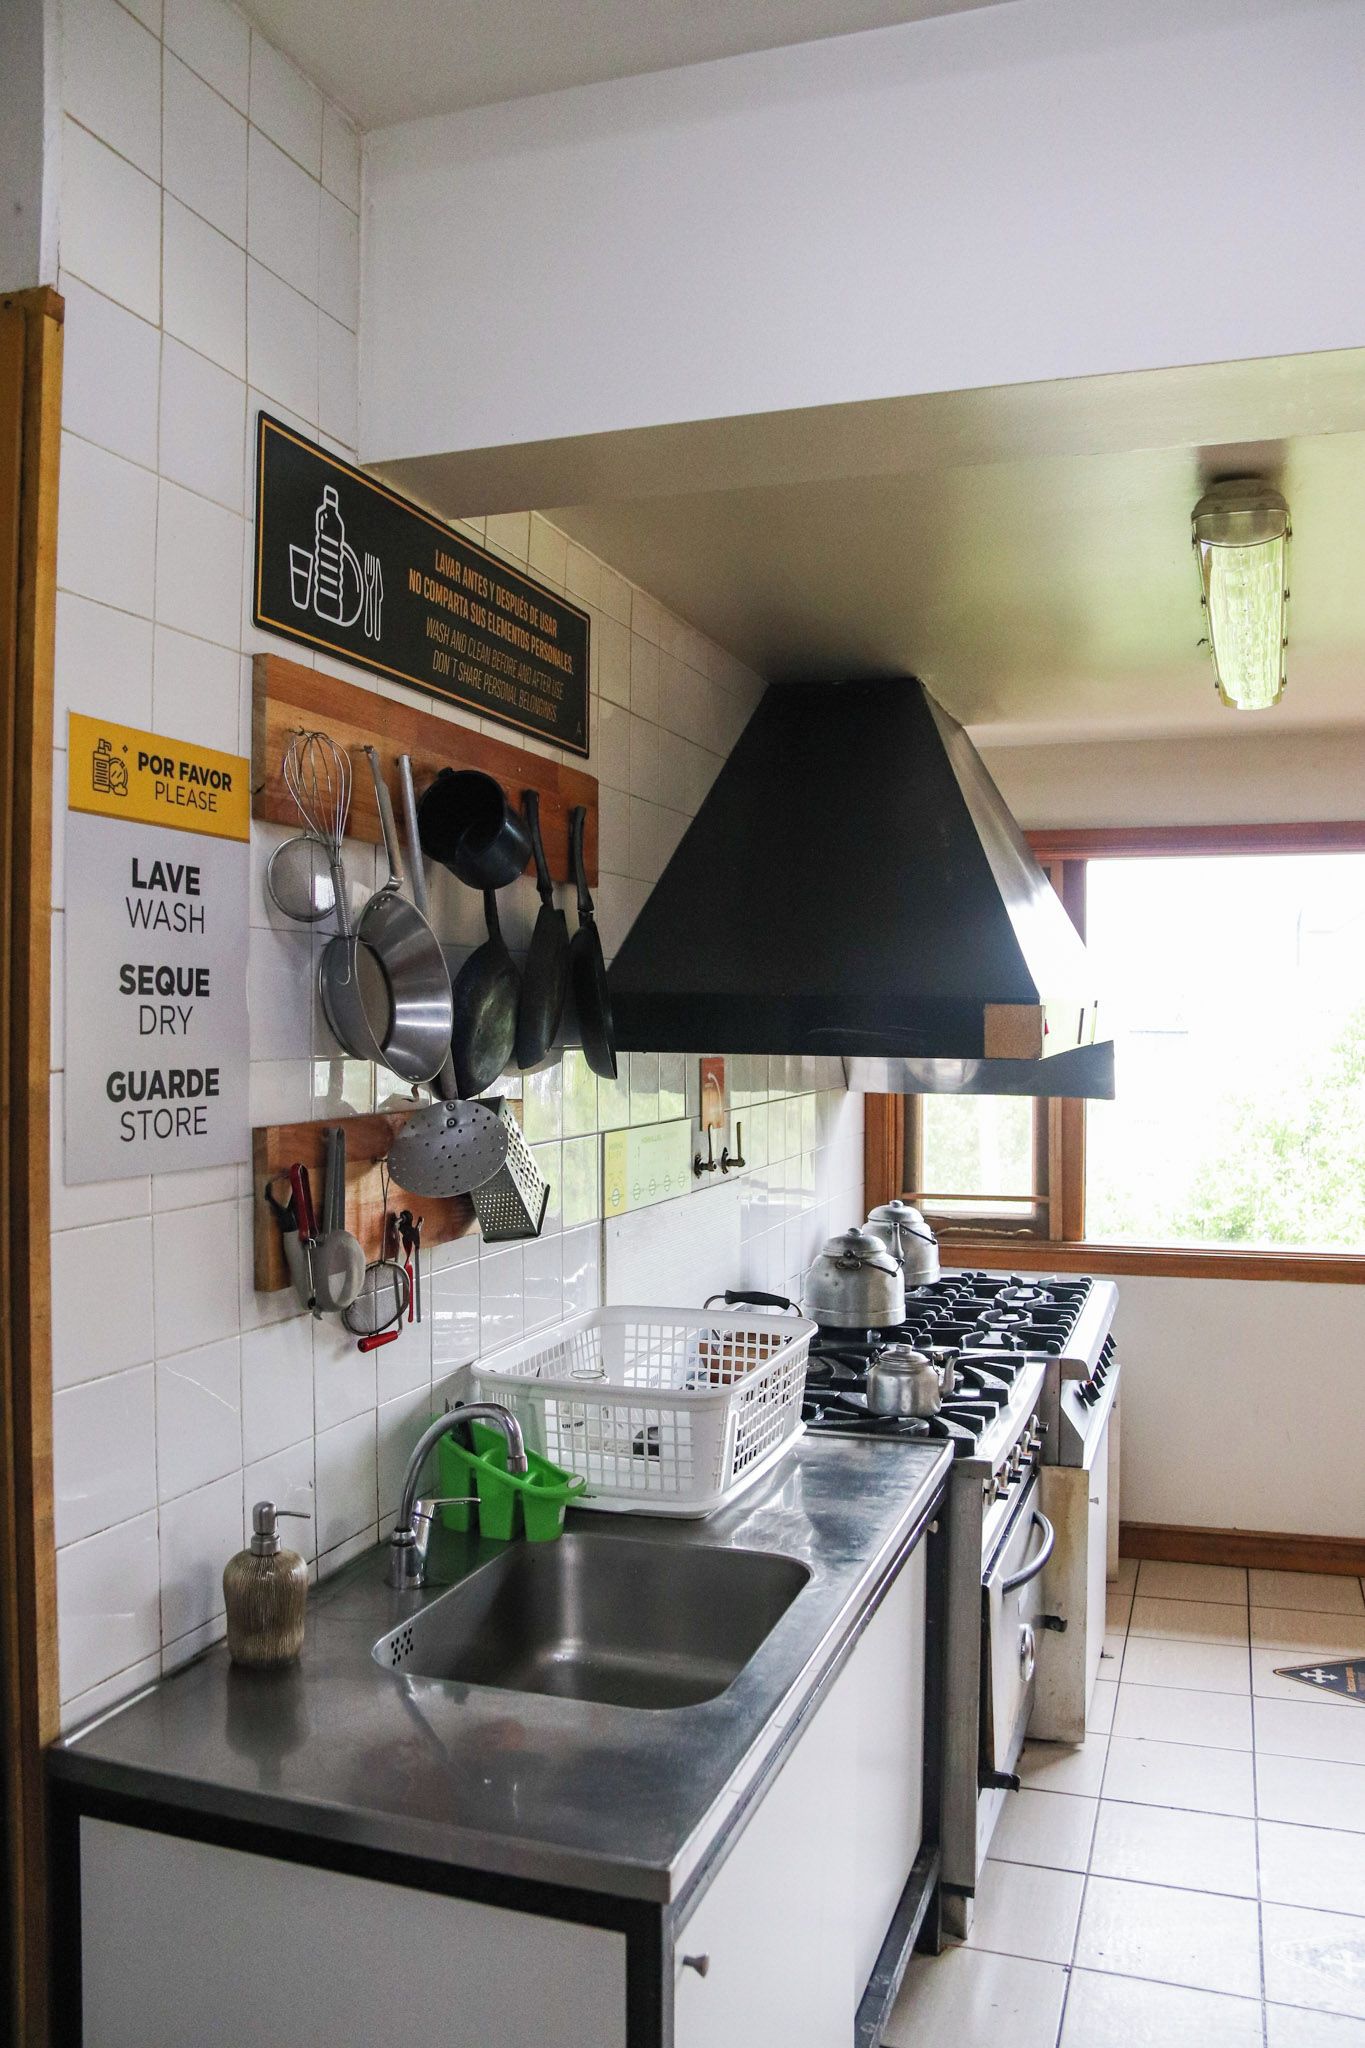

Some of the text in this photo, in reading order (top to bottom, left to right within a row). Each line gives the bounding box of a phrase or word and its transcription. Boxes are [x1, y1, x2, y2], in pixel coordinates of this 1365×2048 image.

[408, 568, 421, 595] NO
[423, 577, 469, 620] COMPARTA
[470, 602, 486, 628] SUS
[488, 612, 530, 652] ELEMENTOS
[434, 549, 558, 638] LAVAR ANTES Y DESPUÉS DE USAR
[426, 617, 450, 645] WASH
[450, 629, 466, 653] AND
[467, 637, 491, 666] CLEAN
[491, 651, 518, 679] BEFORE
[458, 661, 483, 690] SHARE
[483, 672, 518, 706] PERSONAL
[138, 751, 232, 792] POR FAVOR
[155, 781, 217, 812] PLEASE
[131, 857, 200, 896] LAVE
[125, 896, 205, 934] WASH
[119, 963, 210, 997] SEQUE
[138, 1005, 193, 1036] DRY
[106, 1068, 219, 1102] GUARDE
[120, 1106, 207, 1142] STORE
